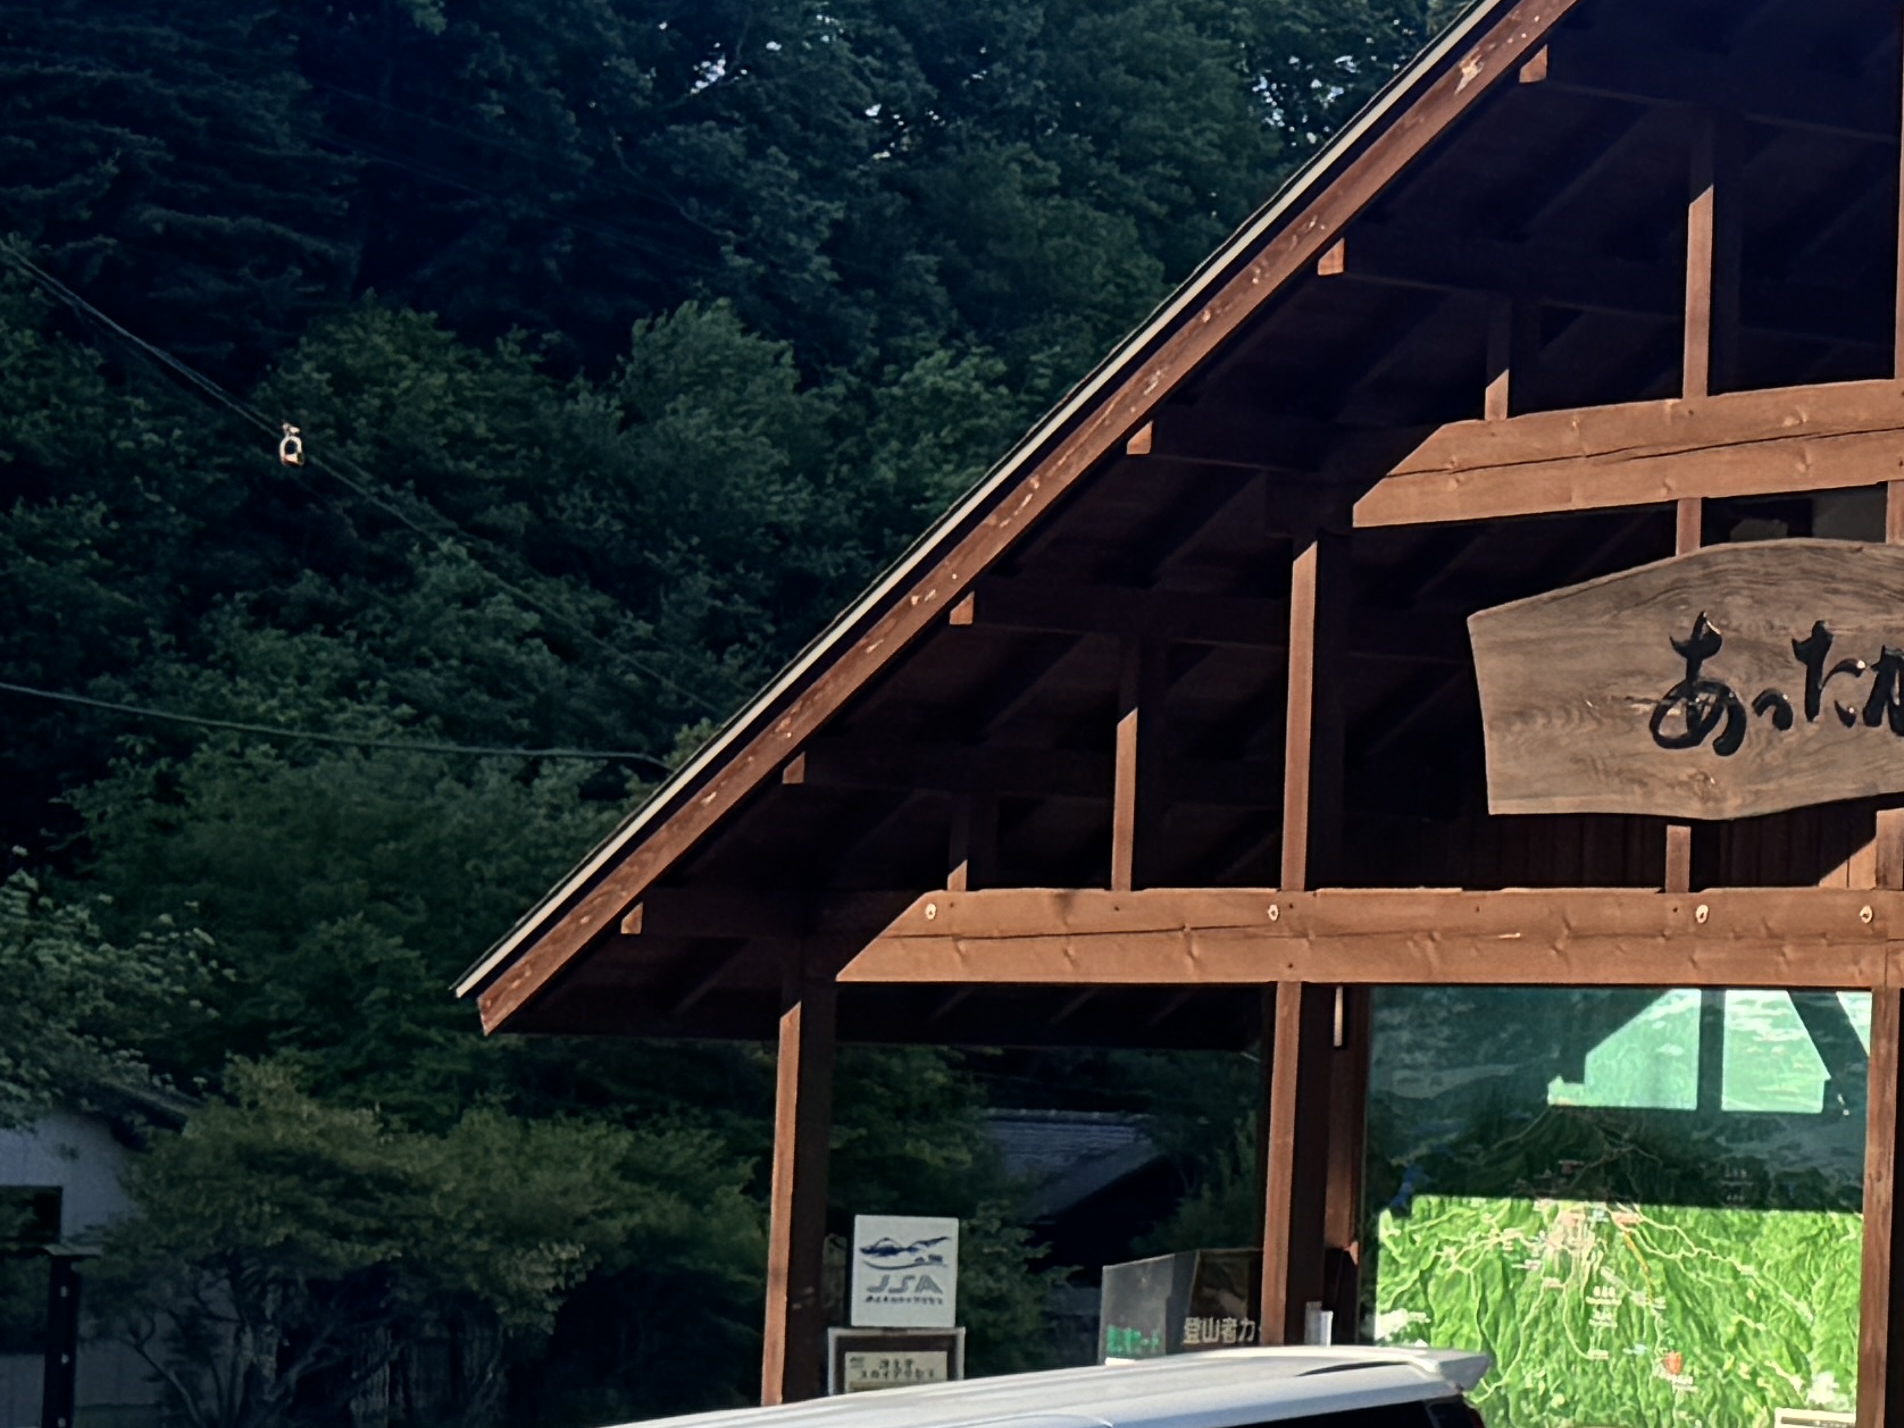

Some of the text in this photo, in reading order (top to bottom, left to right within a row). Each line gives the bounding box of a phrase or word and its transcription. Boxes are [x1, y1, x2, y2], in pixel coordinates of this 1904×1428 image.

[866, 1274, 944, 1294] JSA
[1183, 1316, 1262, 1344] 登山者カ
